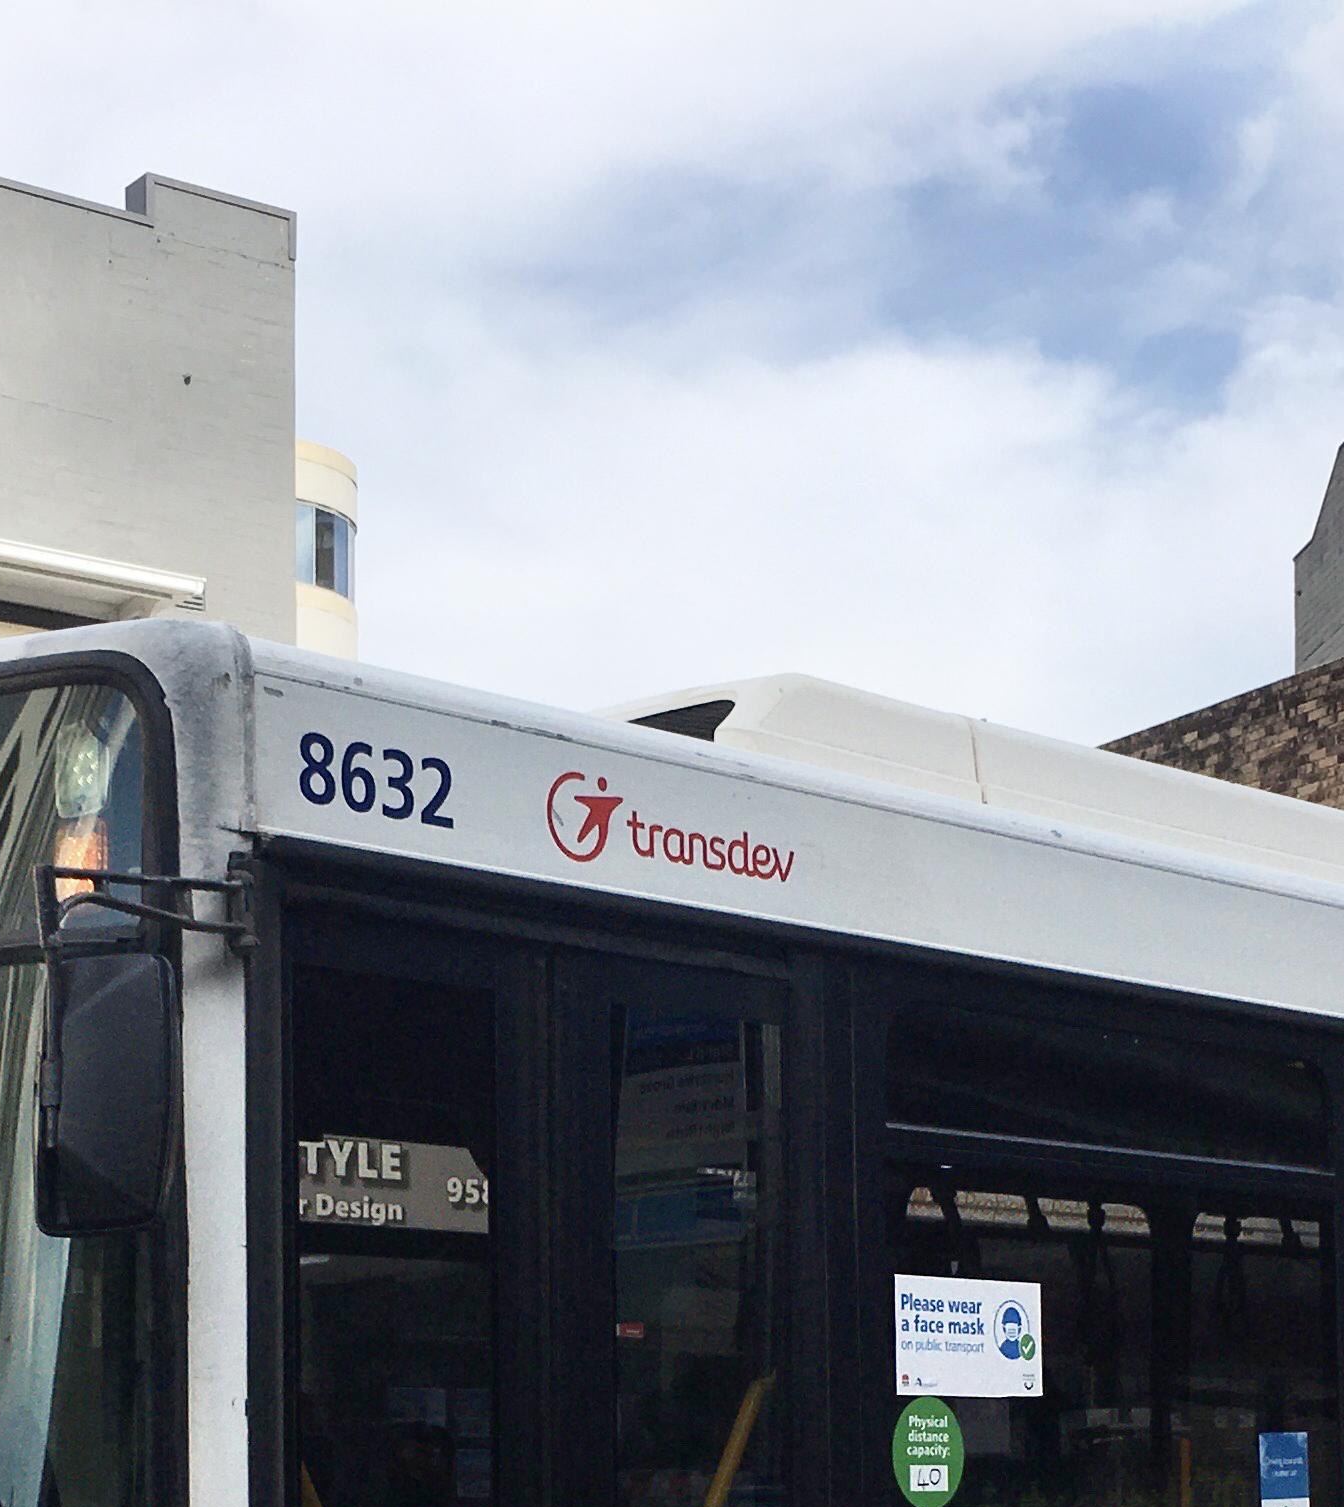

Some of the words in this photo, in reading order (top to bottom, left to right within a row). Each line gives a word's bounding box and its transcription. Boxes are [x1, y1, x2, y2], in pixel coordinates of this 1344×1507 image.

[299, 731, 455, 830] 8632
[627, 809, 795, 883] transdev
[298, 1138, 403, 1181] TYLE
[315, 1193, 404, 1226] Design
[900, 1292, 945, 1313] Please
[947, 1299, 983, 1315] wear
[900, 1318, 910, 1333] a
[913, 1313, 945, 1334] face
[948, 1317, 986, 1336] mask
[900, 1340, 914, 1351] on
[915, 1337, 942, 1354] public
[944, 1339, 985, 1356] transport
[907, 1415, 949, 1431] Physical
[907, 1429, 950, 1443] distance
[906, 1443, 951, 1459] capacity:
[916, 1468, 943, 1492] 40
